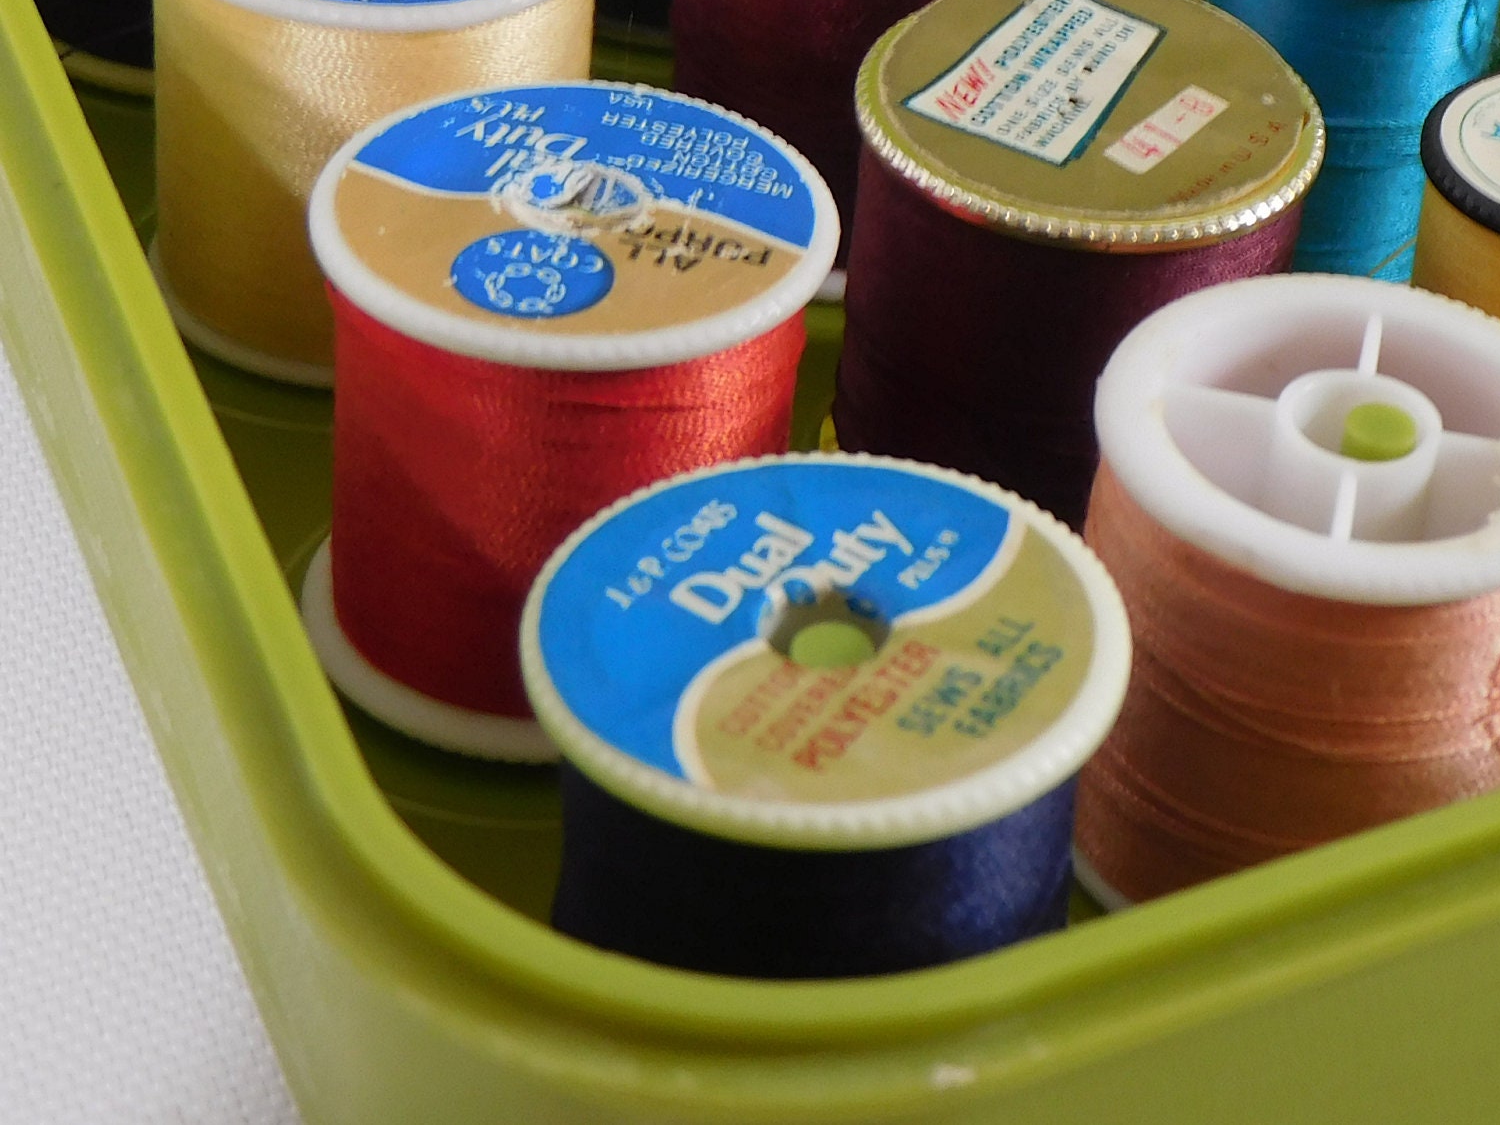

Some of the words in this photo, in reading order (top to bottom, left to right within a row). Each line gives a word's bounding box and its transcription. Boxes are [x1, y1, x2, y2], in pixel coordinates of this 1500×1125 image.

[935, 57, 996, 123] NEW!
[454, 113, 588, 162] Duty
[602, 111, 750, 150] POLYESTER
[669, 510, 815, 625] Dual
